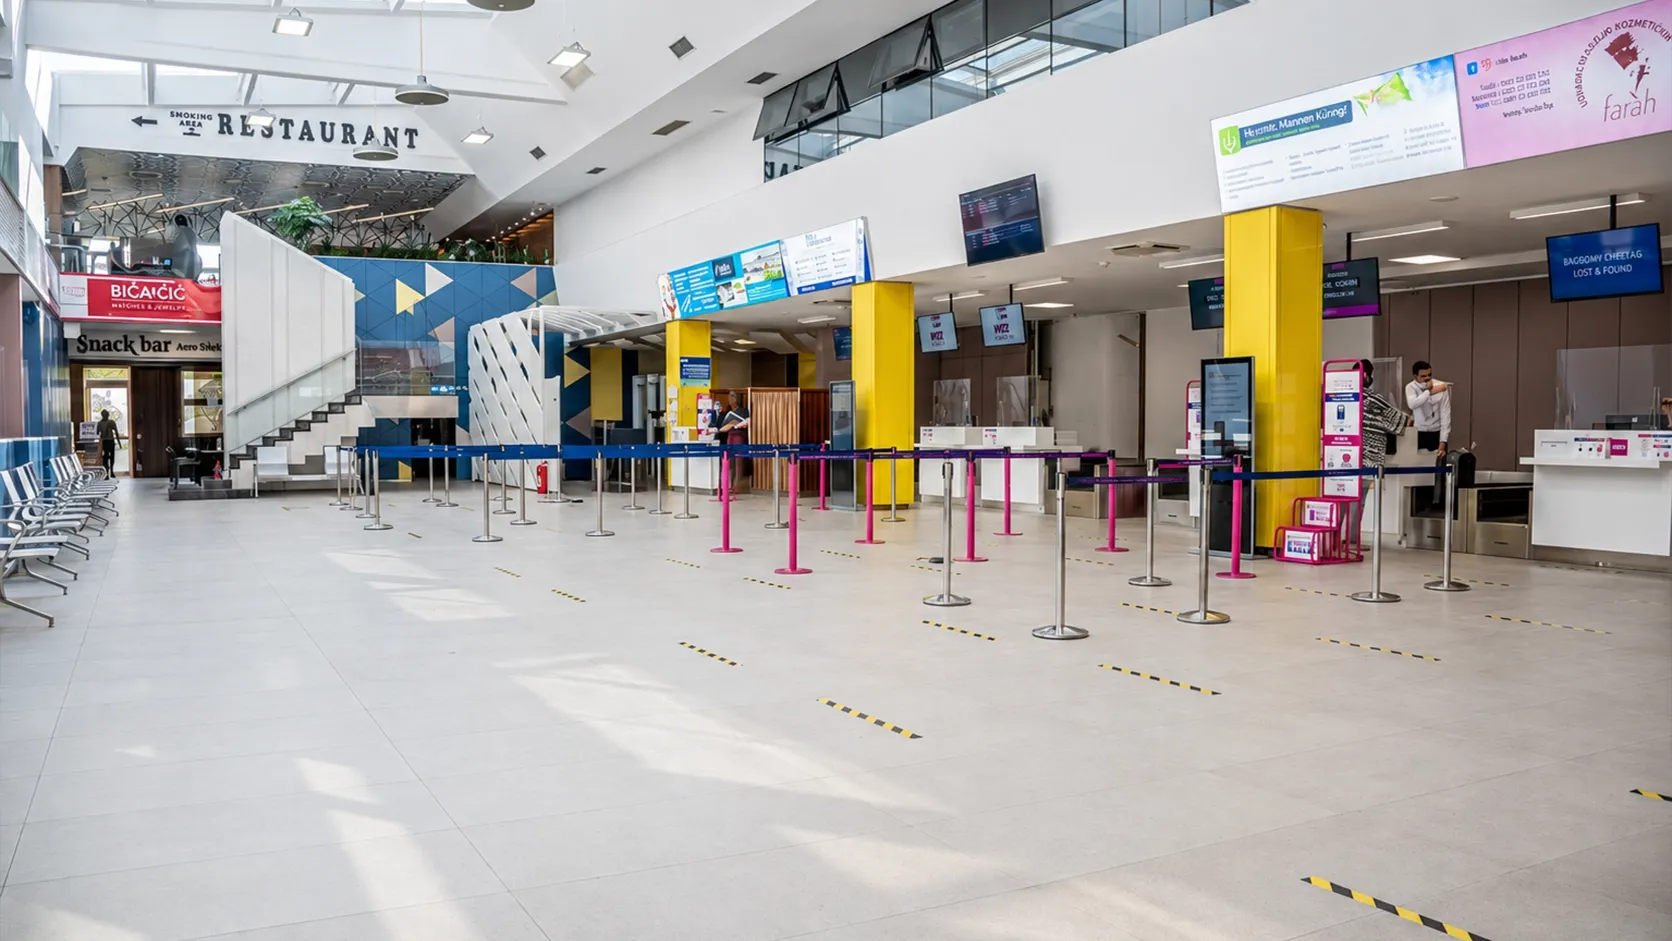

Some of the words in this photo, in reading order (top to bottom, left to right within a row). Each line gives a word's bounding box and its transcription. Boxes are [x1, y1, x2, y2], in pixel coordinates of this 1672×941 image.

[169, 110, 213, 121] SMOKING
[179, 119, 203, 128] AREA
[1573, 267, 1593, 278] LOST
[1594, 266, 1601, 276] &
[1603, 264, 1633, 275] FOUND
[76, 334, 140, 356] Snack
[139, 335, 172, 352] bar
[176, 343, 198, 351] Aero
